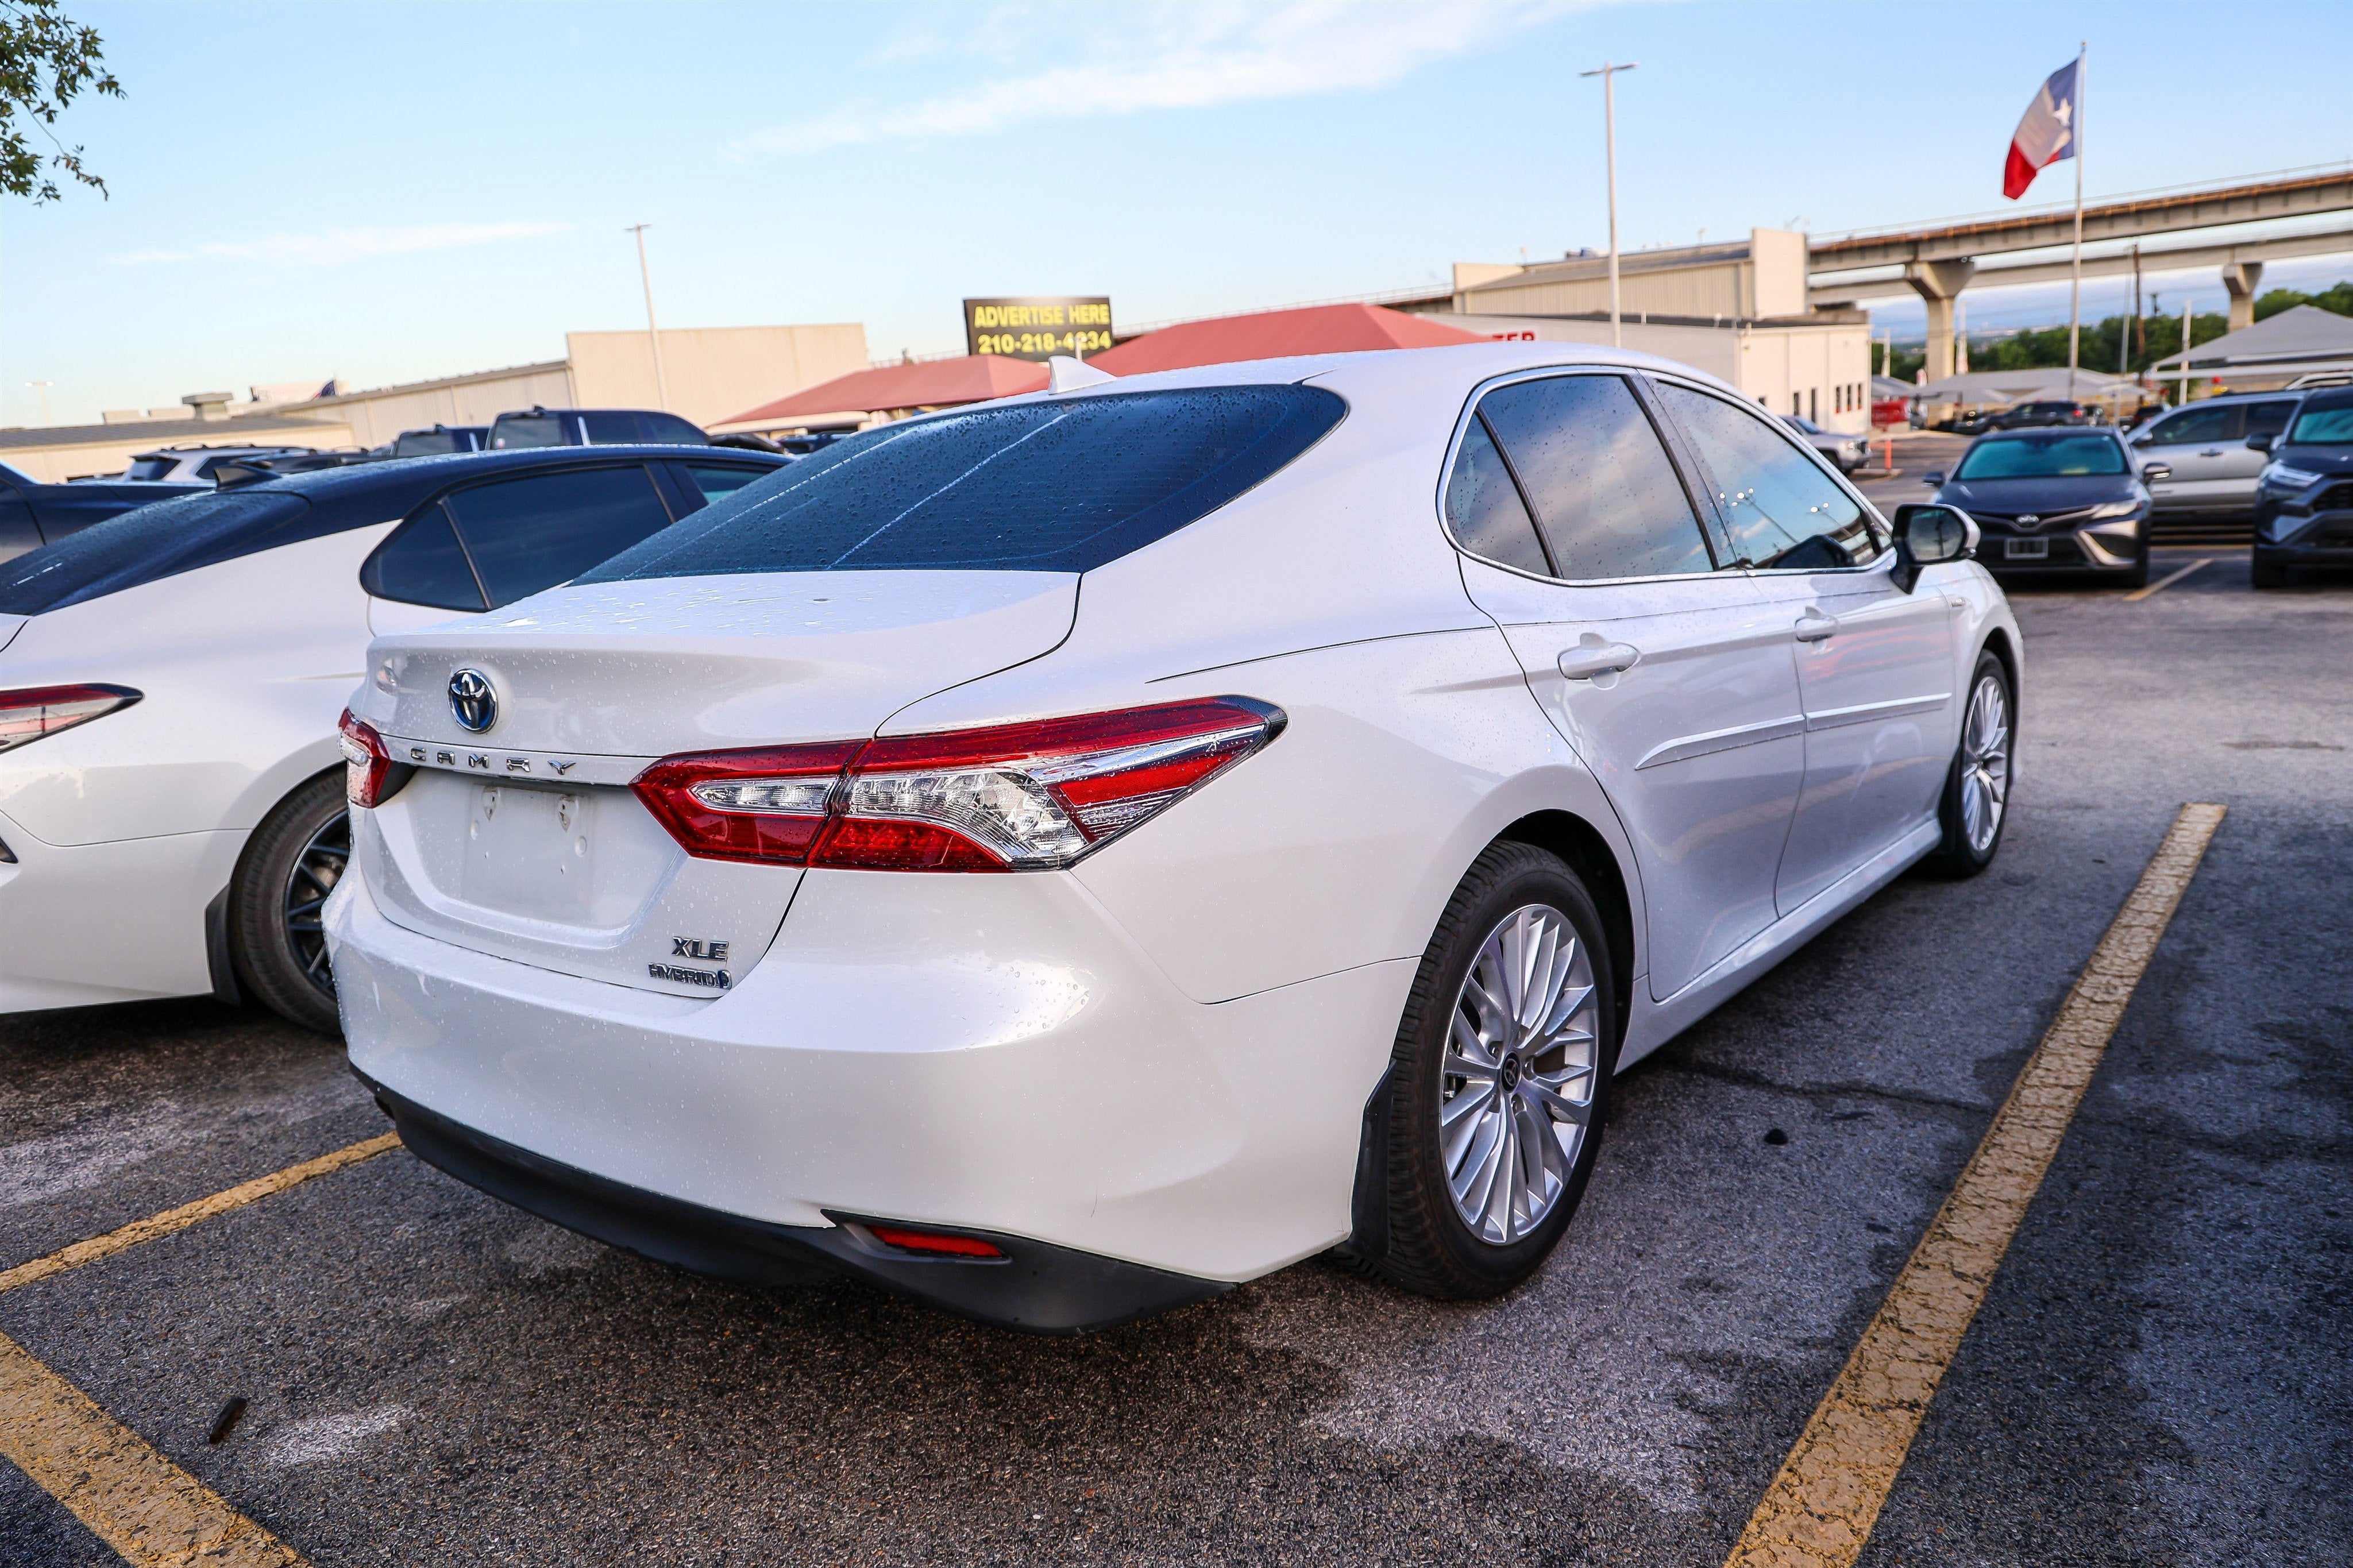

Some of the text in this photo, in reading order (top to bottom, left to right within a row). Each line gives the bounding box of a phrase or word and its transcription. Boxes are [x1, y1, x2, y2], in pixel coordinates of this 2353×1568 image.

[974, 304, 1110, 328] ADVERTISE HERE
[410, 747, 576, 775] CAMRY
[671, 936, 729, 961] XLE
[648, 963, 718, 988] HYBRID
